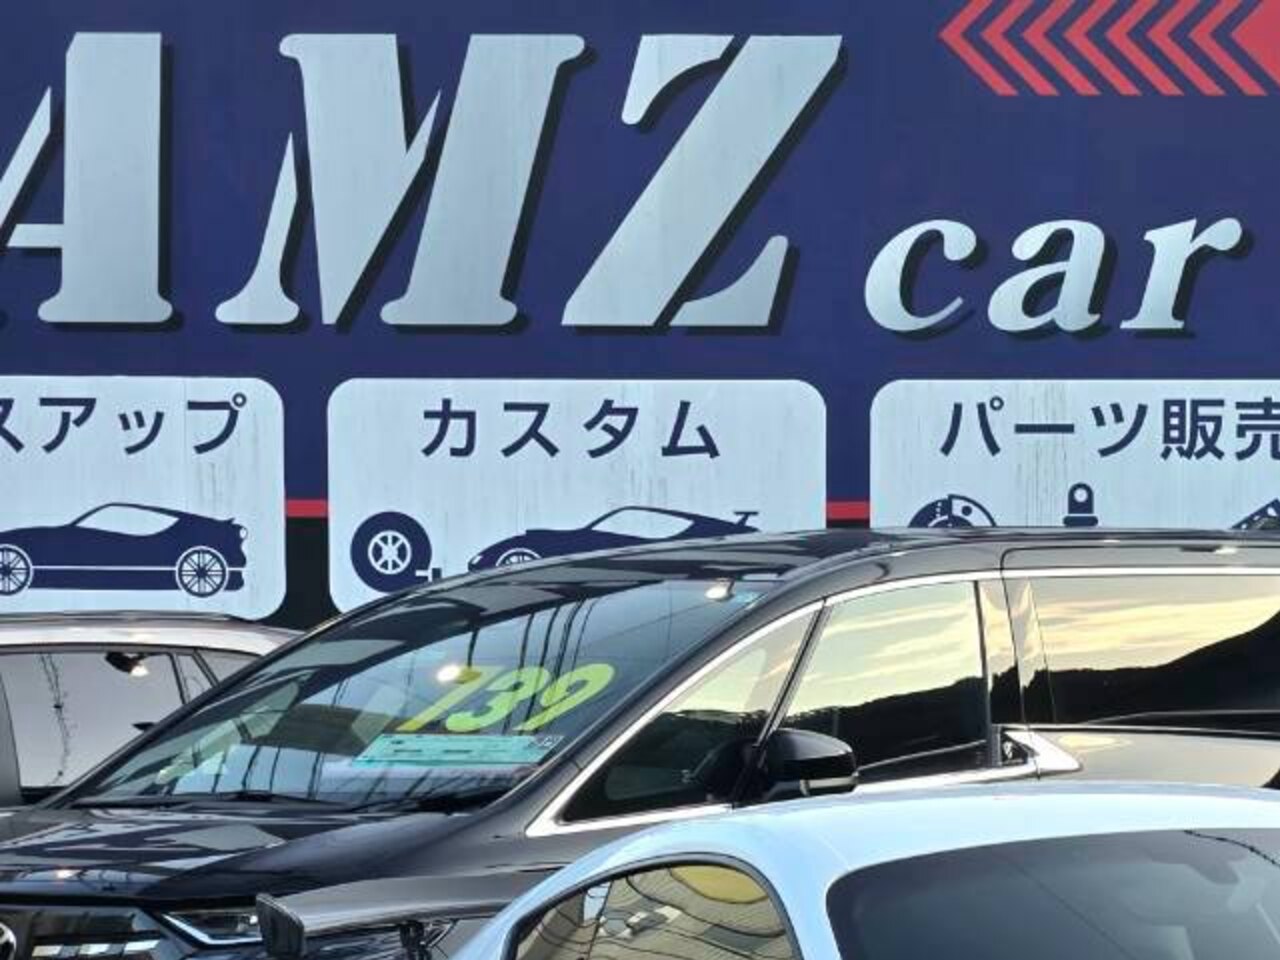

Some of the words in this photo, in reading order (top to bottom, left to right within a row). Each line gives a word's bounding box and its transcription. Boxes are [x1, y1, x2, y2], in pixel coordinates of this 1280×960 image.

[864, 217, 1242, 332] car
[421, 397, 721, 460] カスタム
[396, 663, 615, 733] 739
